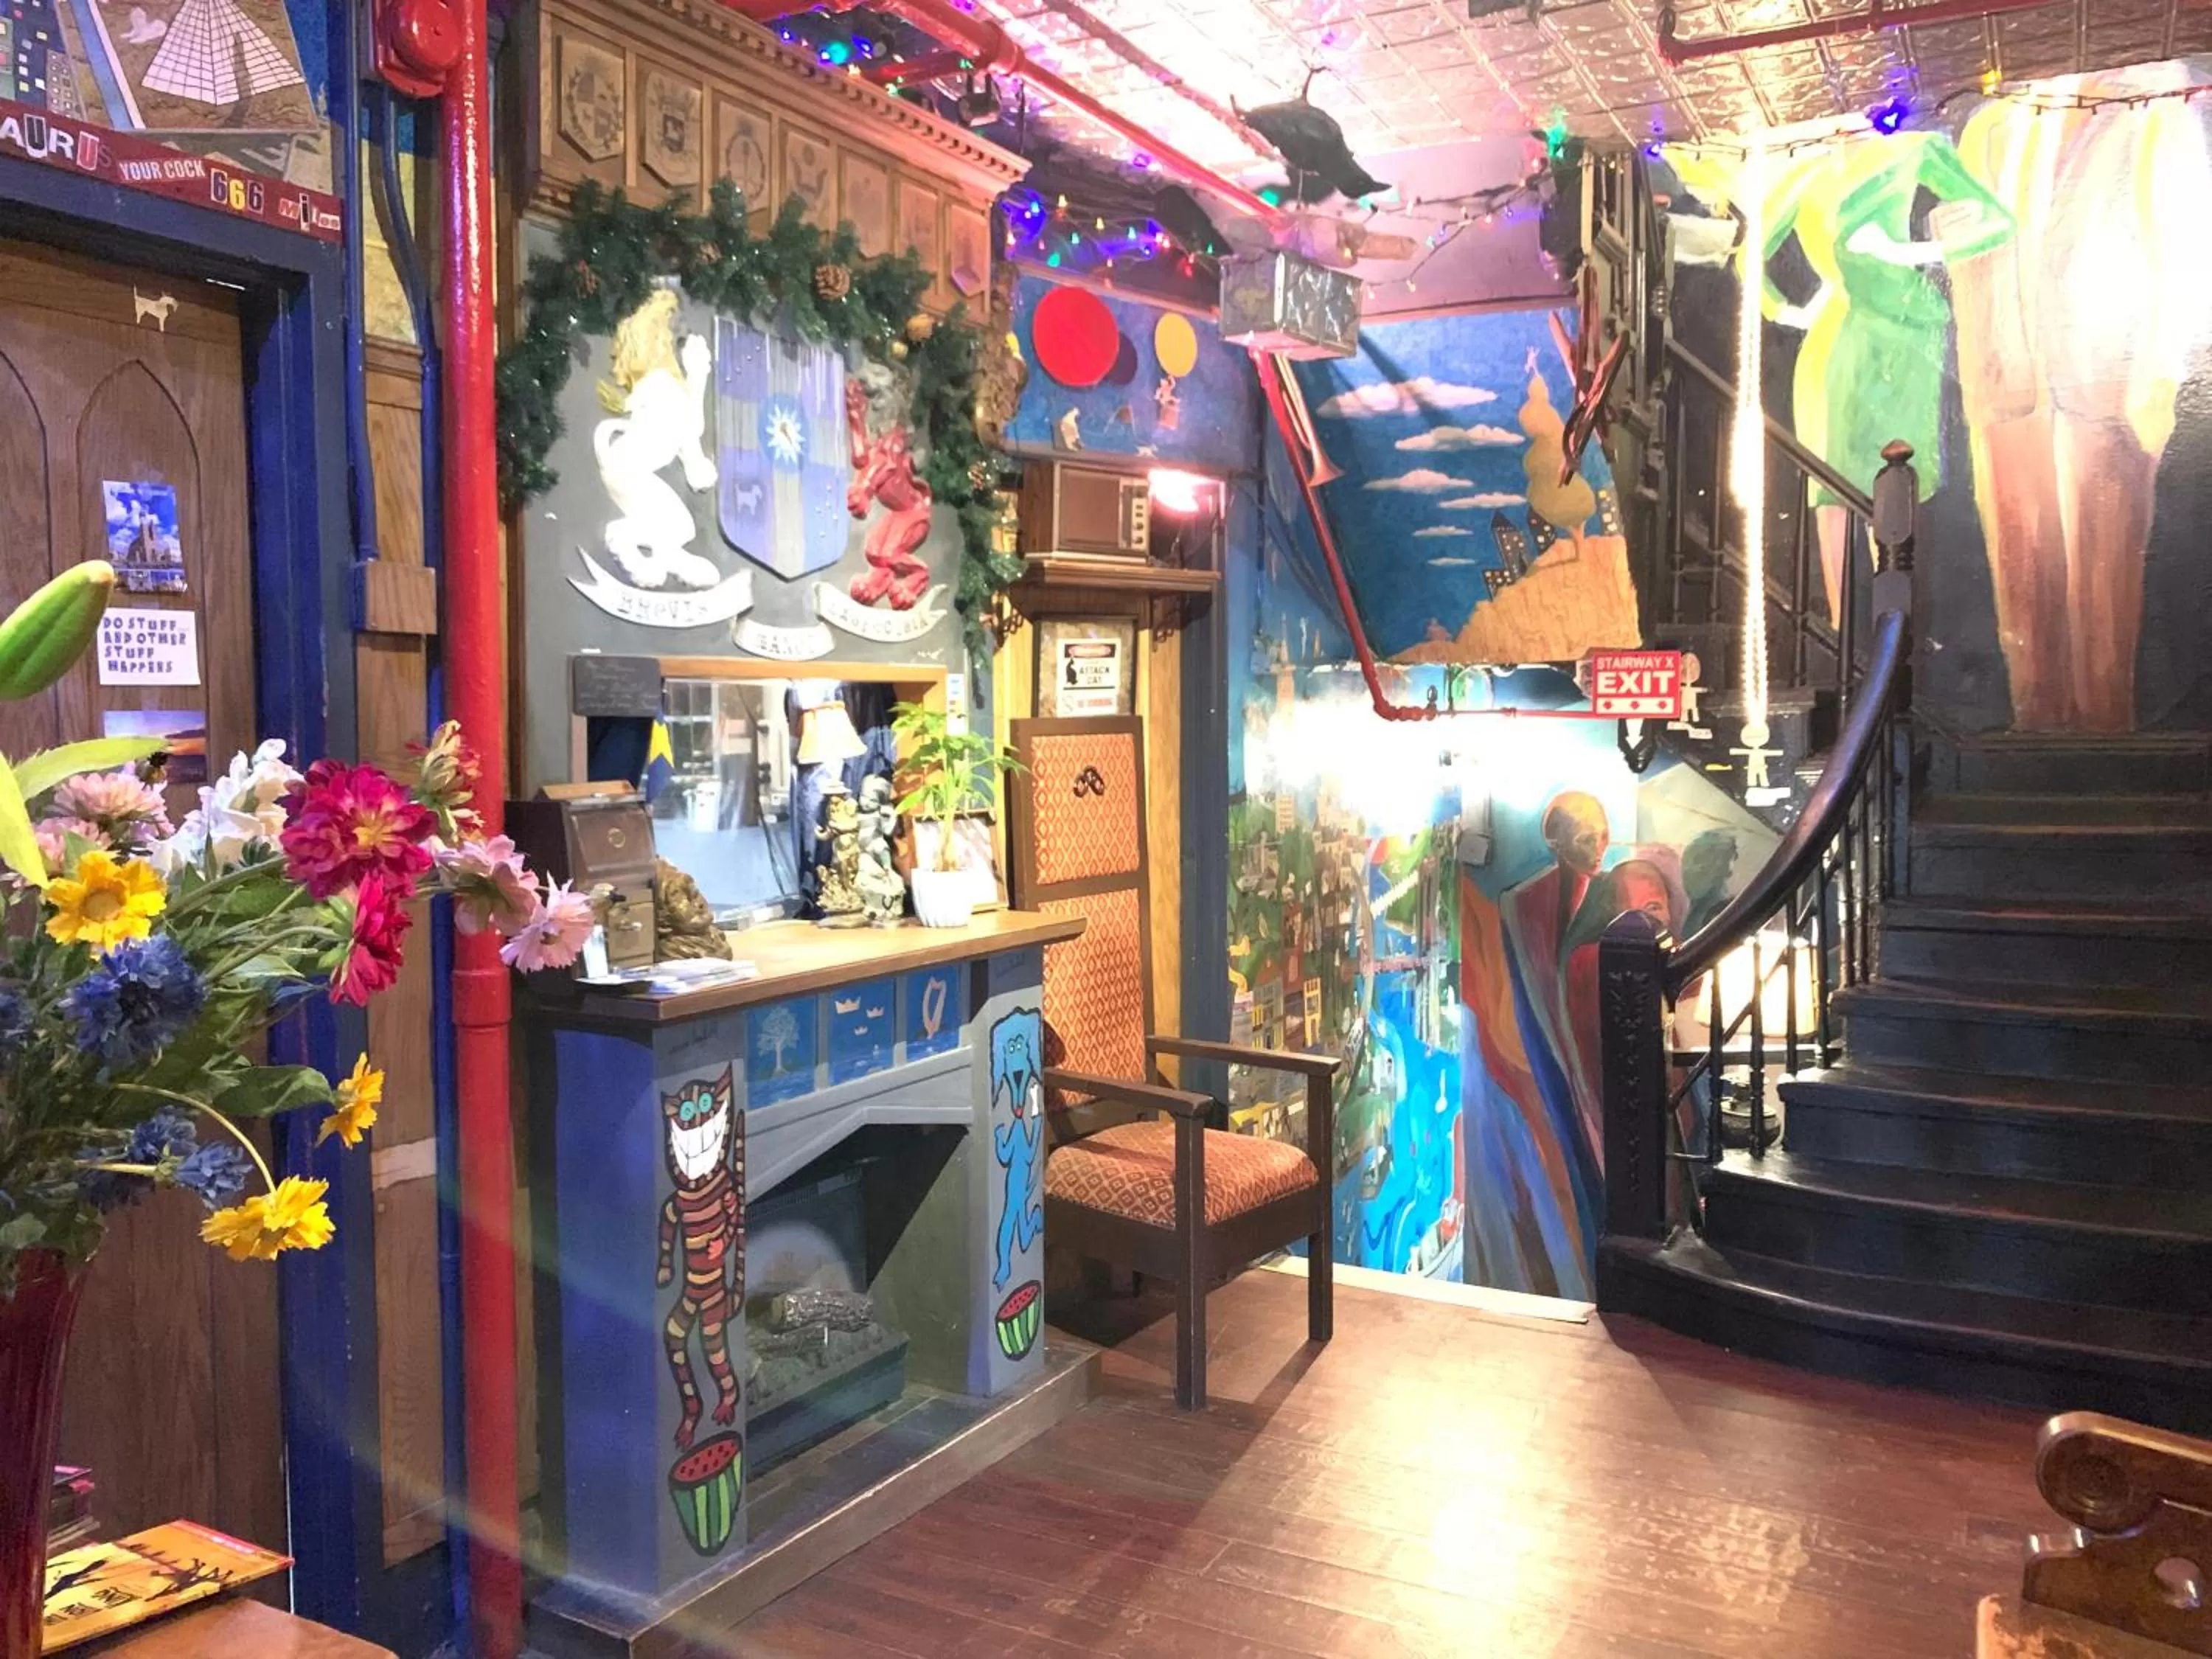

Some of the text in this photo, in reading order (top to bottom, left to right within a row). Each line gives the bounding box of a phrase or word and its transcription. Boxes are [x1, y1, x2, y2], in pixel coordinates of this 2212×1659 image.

[119, 159, 162, 181] YOUR
[163, 159, 206, 179] COCK
[211, 167, 265, 215] 666
[103, 616, 123, 629] DO
[104, 630, 186, 646] AND OTHER
[104, 645, 154, 658] STUFF
[108, 660, 173, 673] HAPPENS
[1596, 655, 1674, 670] STAIRWAY X
[1597, 670, 1676, 695] EXIT
